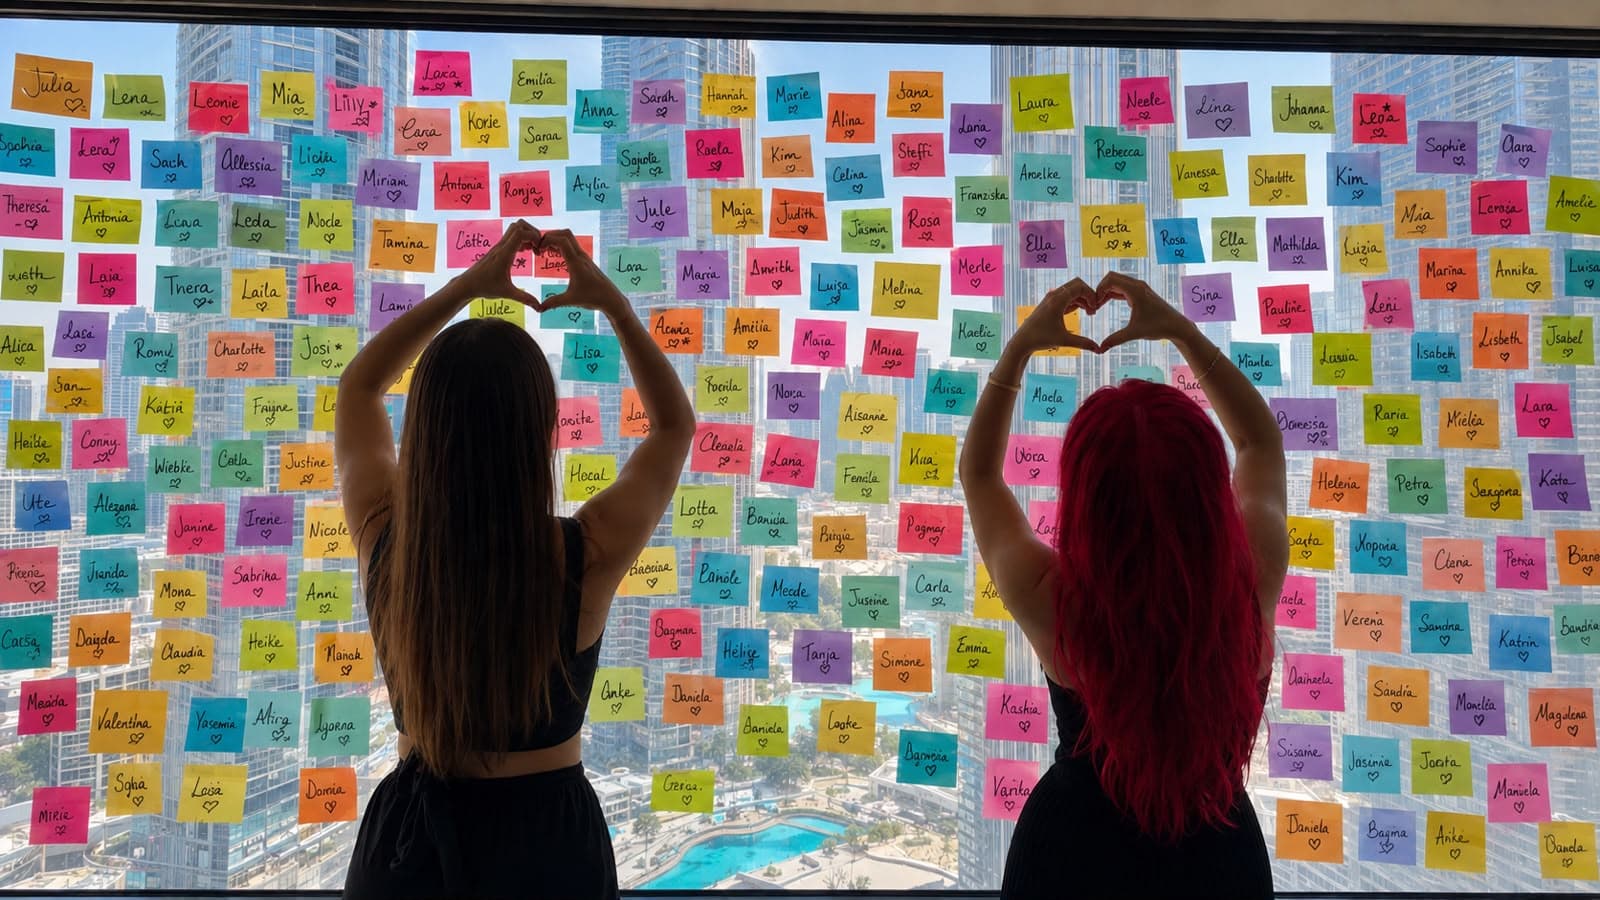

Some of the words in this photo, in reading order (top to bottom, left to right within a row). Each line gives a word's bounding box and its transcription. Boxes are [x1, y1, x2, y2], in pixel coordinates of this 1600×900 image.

[23, 67, 80, 98] Julia
[517, 71, 555, 86] Emilia
[112, 88, 158, 104] Lena
[193, 88, 239, 108] Leonie
[272, 82, 304, 105] Mia
[639, 88, 678, 105] Sarah
[707, 86, 748, 102] Hannah
[776, 88, 811, 104] Marie
[1018, 92, 1059, 112] Laura
[1126, 91, 1166, 108] Neele
[581, 98, 619, 118] Anna
[1195, 96, 1237, 115] Lina
[1280, 93, 1330, 121] Johanna
[832, 111, 864, 127] Alina
[898, 143, 933, 159] Steffi
[1094, 139, 1144, 158] Rebecca
[1425, 137, 1466, 158] Sophie
[1502, 134, 1536, 153] Clara
[771, 146, 801, 161] Kim
[833, 167, 868, 182] Celina
[1176, 164, 1220, 180] Vanessa
[1337, 166, 1368, 185] Kim
[440, 174, 484, 192] Antonia
[573, 176, 609, 197] Aylin
[504, 182, 541, 204] Ronja
[960, 186, 1009, 201] Franziska
[1555, 191, 1598, 209] Amelie
[3, 195, 49, 213] Theresa
[636, 196, 676, 222] Jule
[722, 201, 754, 220] Maja
[777, 200, 818, 224] Judith
[234, 208, 277, 228] Leda
[909, 209, 941, 228] Rosa
[1091, 216, 1131, 236] Greta
[848, 219, 888, 237] Jasmin
[381, 230, 429, 249] Tamina
[1026, 233, 1056, 252] Ella
[1161, 230, 1188, 246] Rosa
[1219, 230, 1248, 247] Ella
[1273, 236, 1320, 252] Mathilda
[616, 255, 648, 273] Lara
[958, 259, 997, 275] Merle
[1426, 264, 1466, 280] Marina
[1496, 262, 1538, 279] Annika
[1570, 258, 1600, 273] Luisa
[242, 283, 280, 300] Laila
[303, 275, 343, 295] Thea
[818, 274, 851, 292] Luisa
[882, 278, 923, 296] Melina
[1191, 286, 1223, 303] Sina
[1262, 299, 1306, 317] Pauline
[214, 340, 266, 358] Charlotte
[574, 341, 605, 361] Lisa
[1522, 393, 1558, 413] Lara
[155, 460, 195, 474] Wiebke
[286, 452, 330, 470] Justine
[1395, 473, 1433, 492] Petra
[22, 494, 56, 512] Ute
[680, 496, 718, 518] Lotta
[174, 515, 217, 537] Janine
[245, 508, 285, 528] Irene
[309, 522, 350, 541] Nicole
[160, 582, 195, 598] Mona
[306, 582, 339, 601] Anni
[915, 574, 952, 593] Carla
[249, 634, 283, 650] Heike
[1498, 629, 1540, 649] Katrin
[161, 642, 207, 660] Claudia
[802, 643, 840, 664] Tanja
[880, 651, 925, 668] Simone
[97, 708, 152, 730] Valentina
